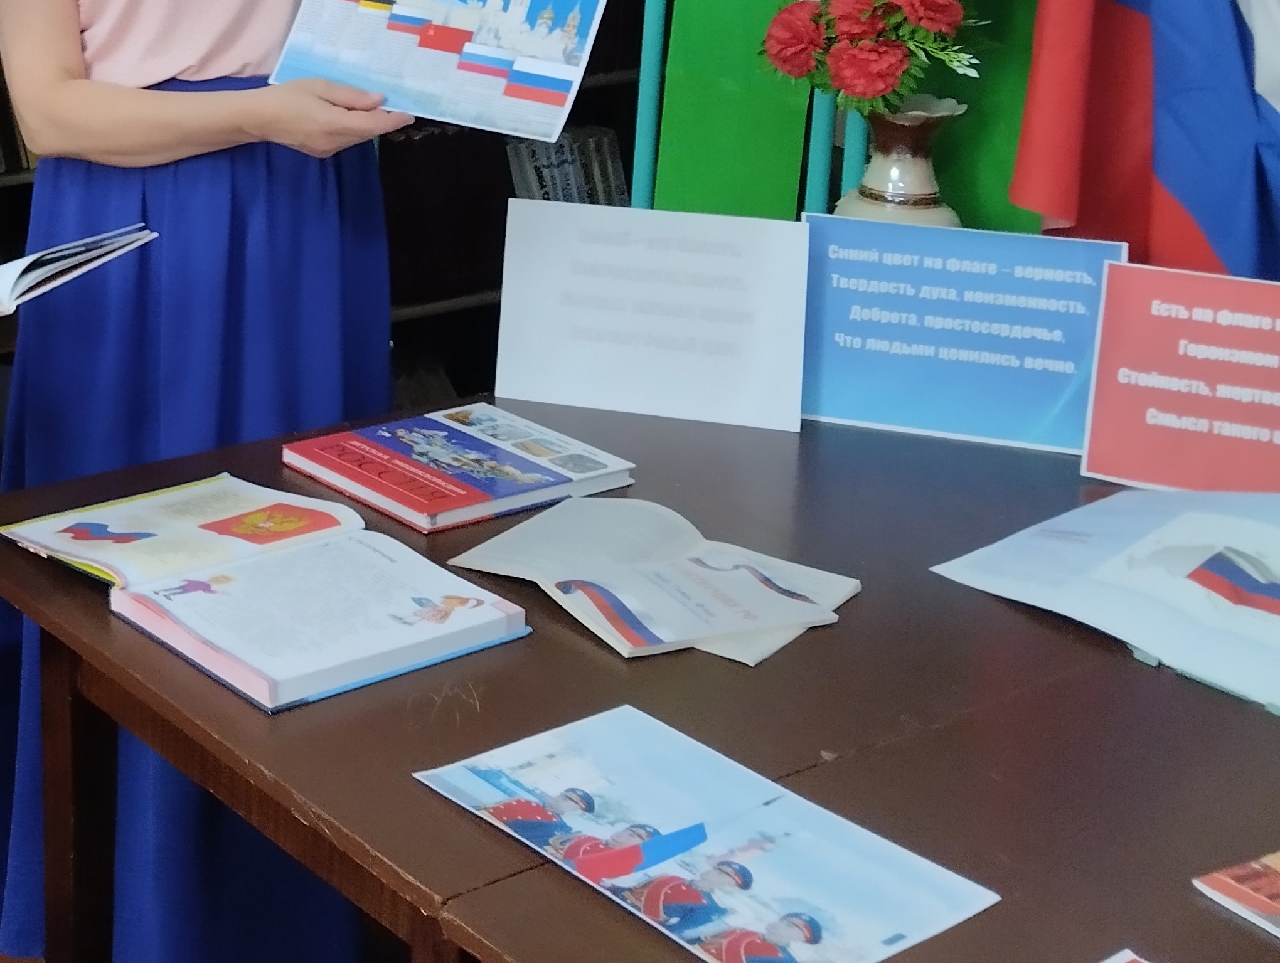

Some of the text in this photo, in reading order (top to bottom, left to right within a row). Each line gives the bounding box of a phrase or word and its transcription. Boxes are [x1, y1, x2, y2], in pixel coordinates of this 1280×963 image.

[828, 244, 879, 263] Синий
[882, 252, 920, 267] цвет
[923, 256, 943, 270] на
[946, 258, 997, 275] флаге
[831, 274, 915, 297] Твердость
[1150, 299, 1190, 320] Есть
[1192, 307, 1214, 323] на
[1216, 309, 1273, 330] флаге
[834, 332, 862, 349] Что
[865, 338, 935, 358] людьми
[938, 348, 1021, 368] ценились
[1145, 407, 1211, 433] Смысл
[1213, 420, 1271, 442] такого
